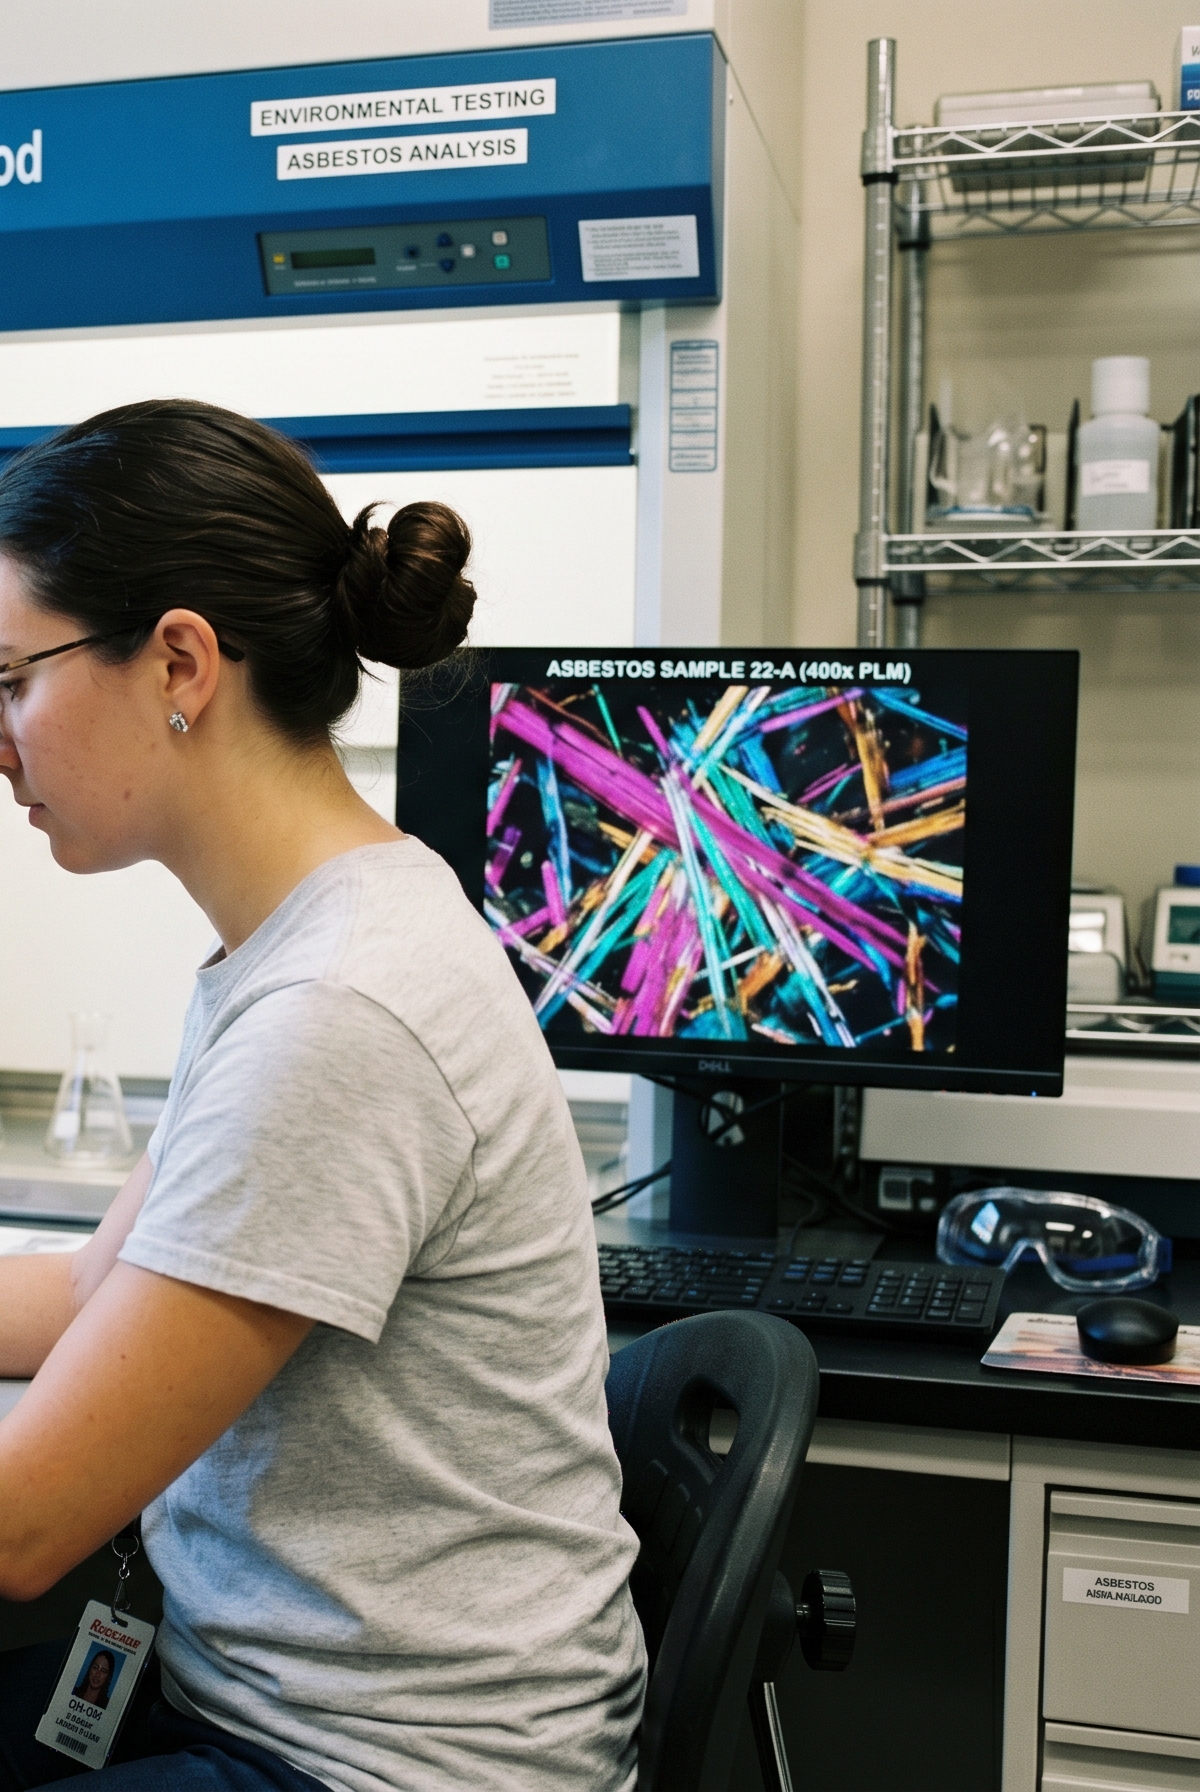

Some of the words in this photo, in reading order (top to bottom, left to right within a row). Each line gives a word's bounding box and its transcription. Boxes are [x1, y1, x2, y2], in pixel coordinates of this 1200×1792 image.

[260, 97, 443, 126] ENVIRONMENTAL
[450, 88, 546, 112] TESTING
[287, 146, 403, 170] ASBESTOS
[409, 138, 517, 162] ANALYSIS
[546, 660, 656, 678] ASBESTOS
[659, 660, 746, 679] SAMPLE
[750, 661, 796, 679] 22-A
[799, 661, 854, 683] (400x
[859, 662, 912, 684] PLM)
[1094, 1577, 1155, 1592] ASBESTOS
